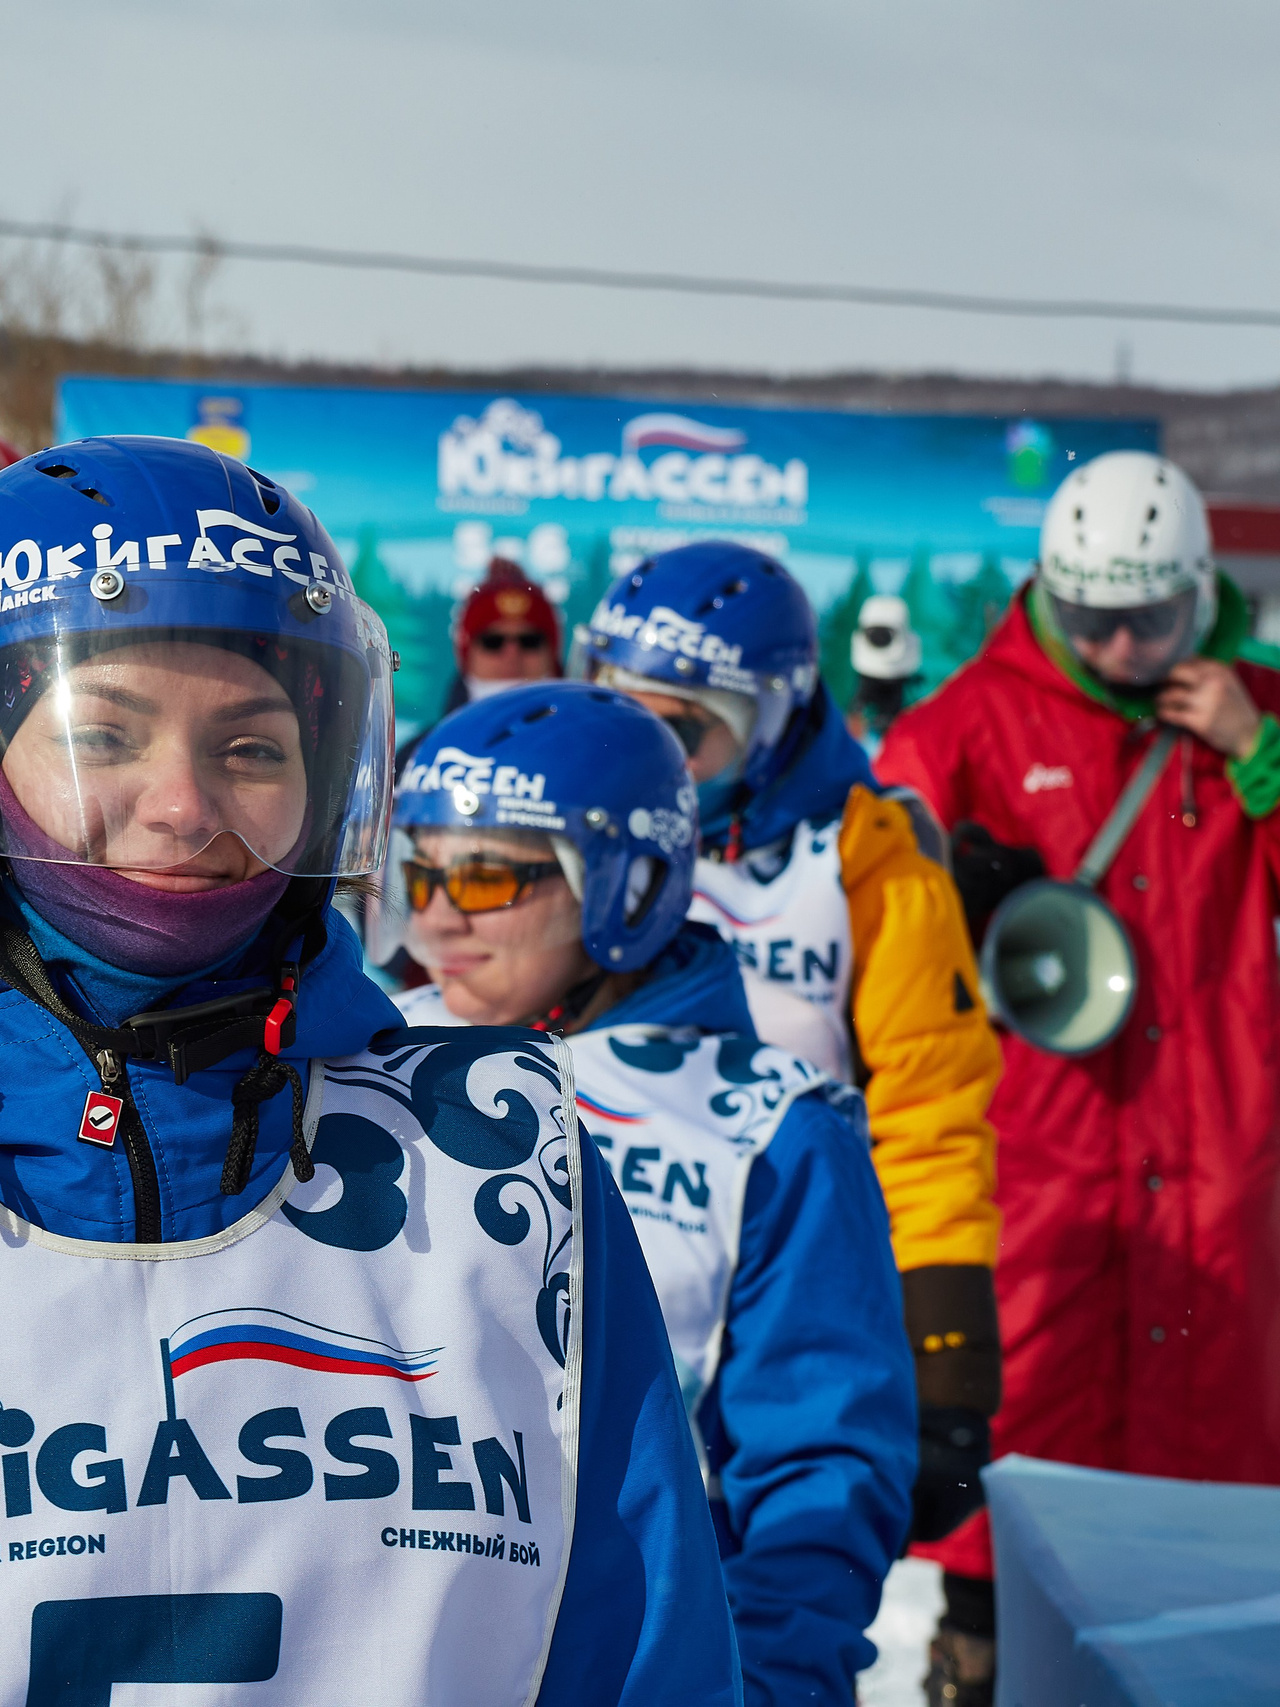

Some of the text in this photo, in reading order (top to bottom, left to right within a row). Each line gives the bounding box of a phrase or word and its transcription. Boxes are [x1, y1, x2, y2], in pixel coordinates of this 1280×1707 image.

[8, 1532, 107, 1562] REGION
[380, 1526, 542, 1568] СНЕЖНЫЙ БОЙ
